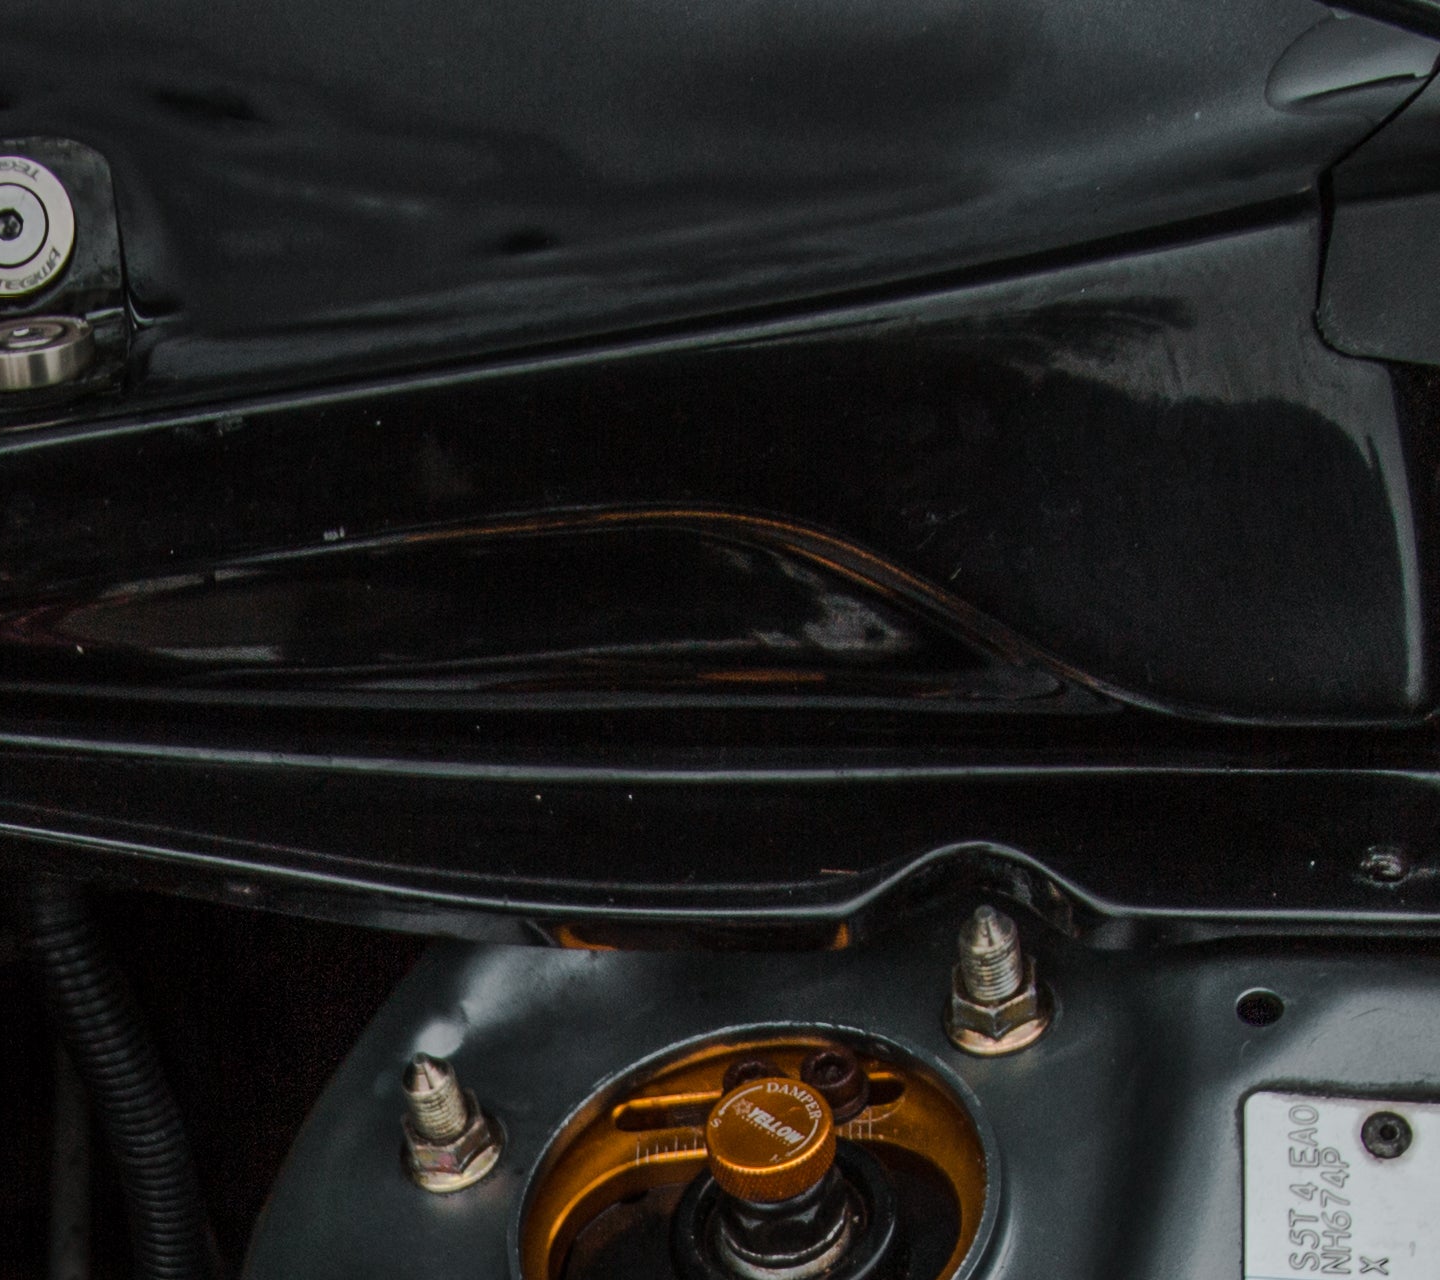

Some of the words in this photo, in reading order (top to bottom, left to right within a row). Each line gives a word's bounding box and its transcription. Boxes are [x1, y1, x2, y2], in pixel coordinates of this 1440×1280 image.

[766, 1081, 823, 1120] DAMPER
[747, 1106, 805, 1145] YELLOW
[1290, 1181, 1319, 1200] 4
[1320, 1146, 1353, 1275] NH674P
[1359, 1256, 1390, 1276] X
